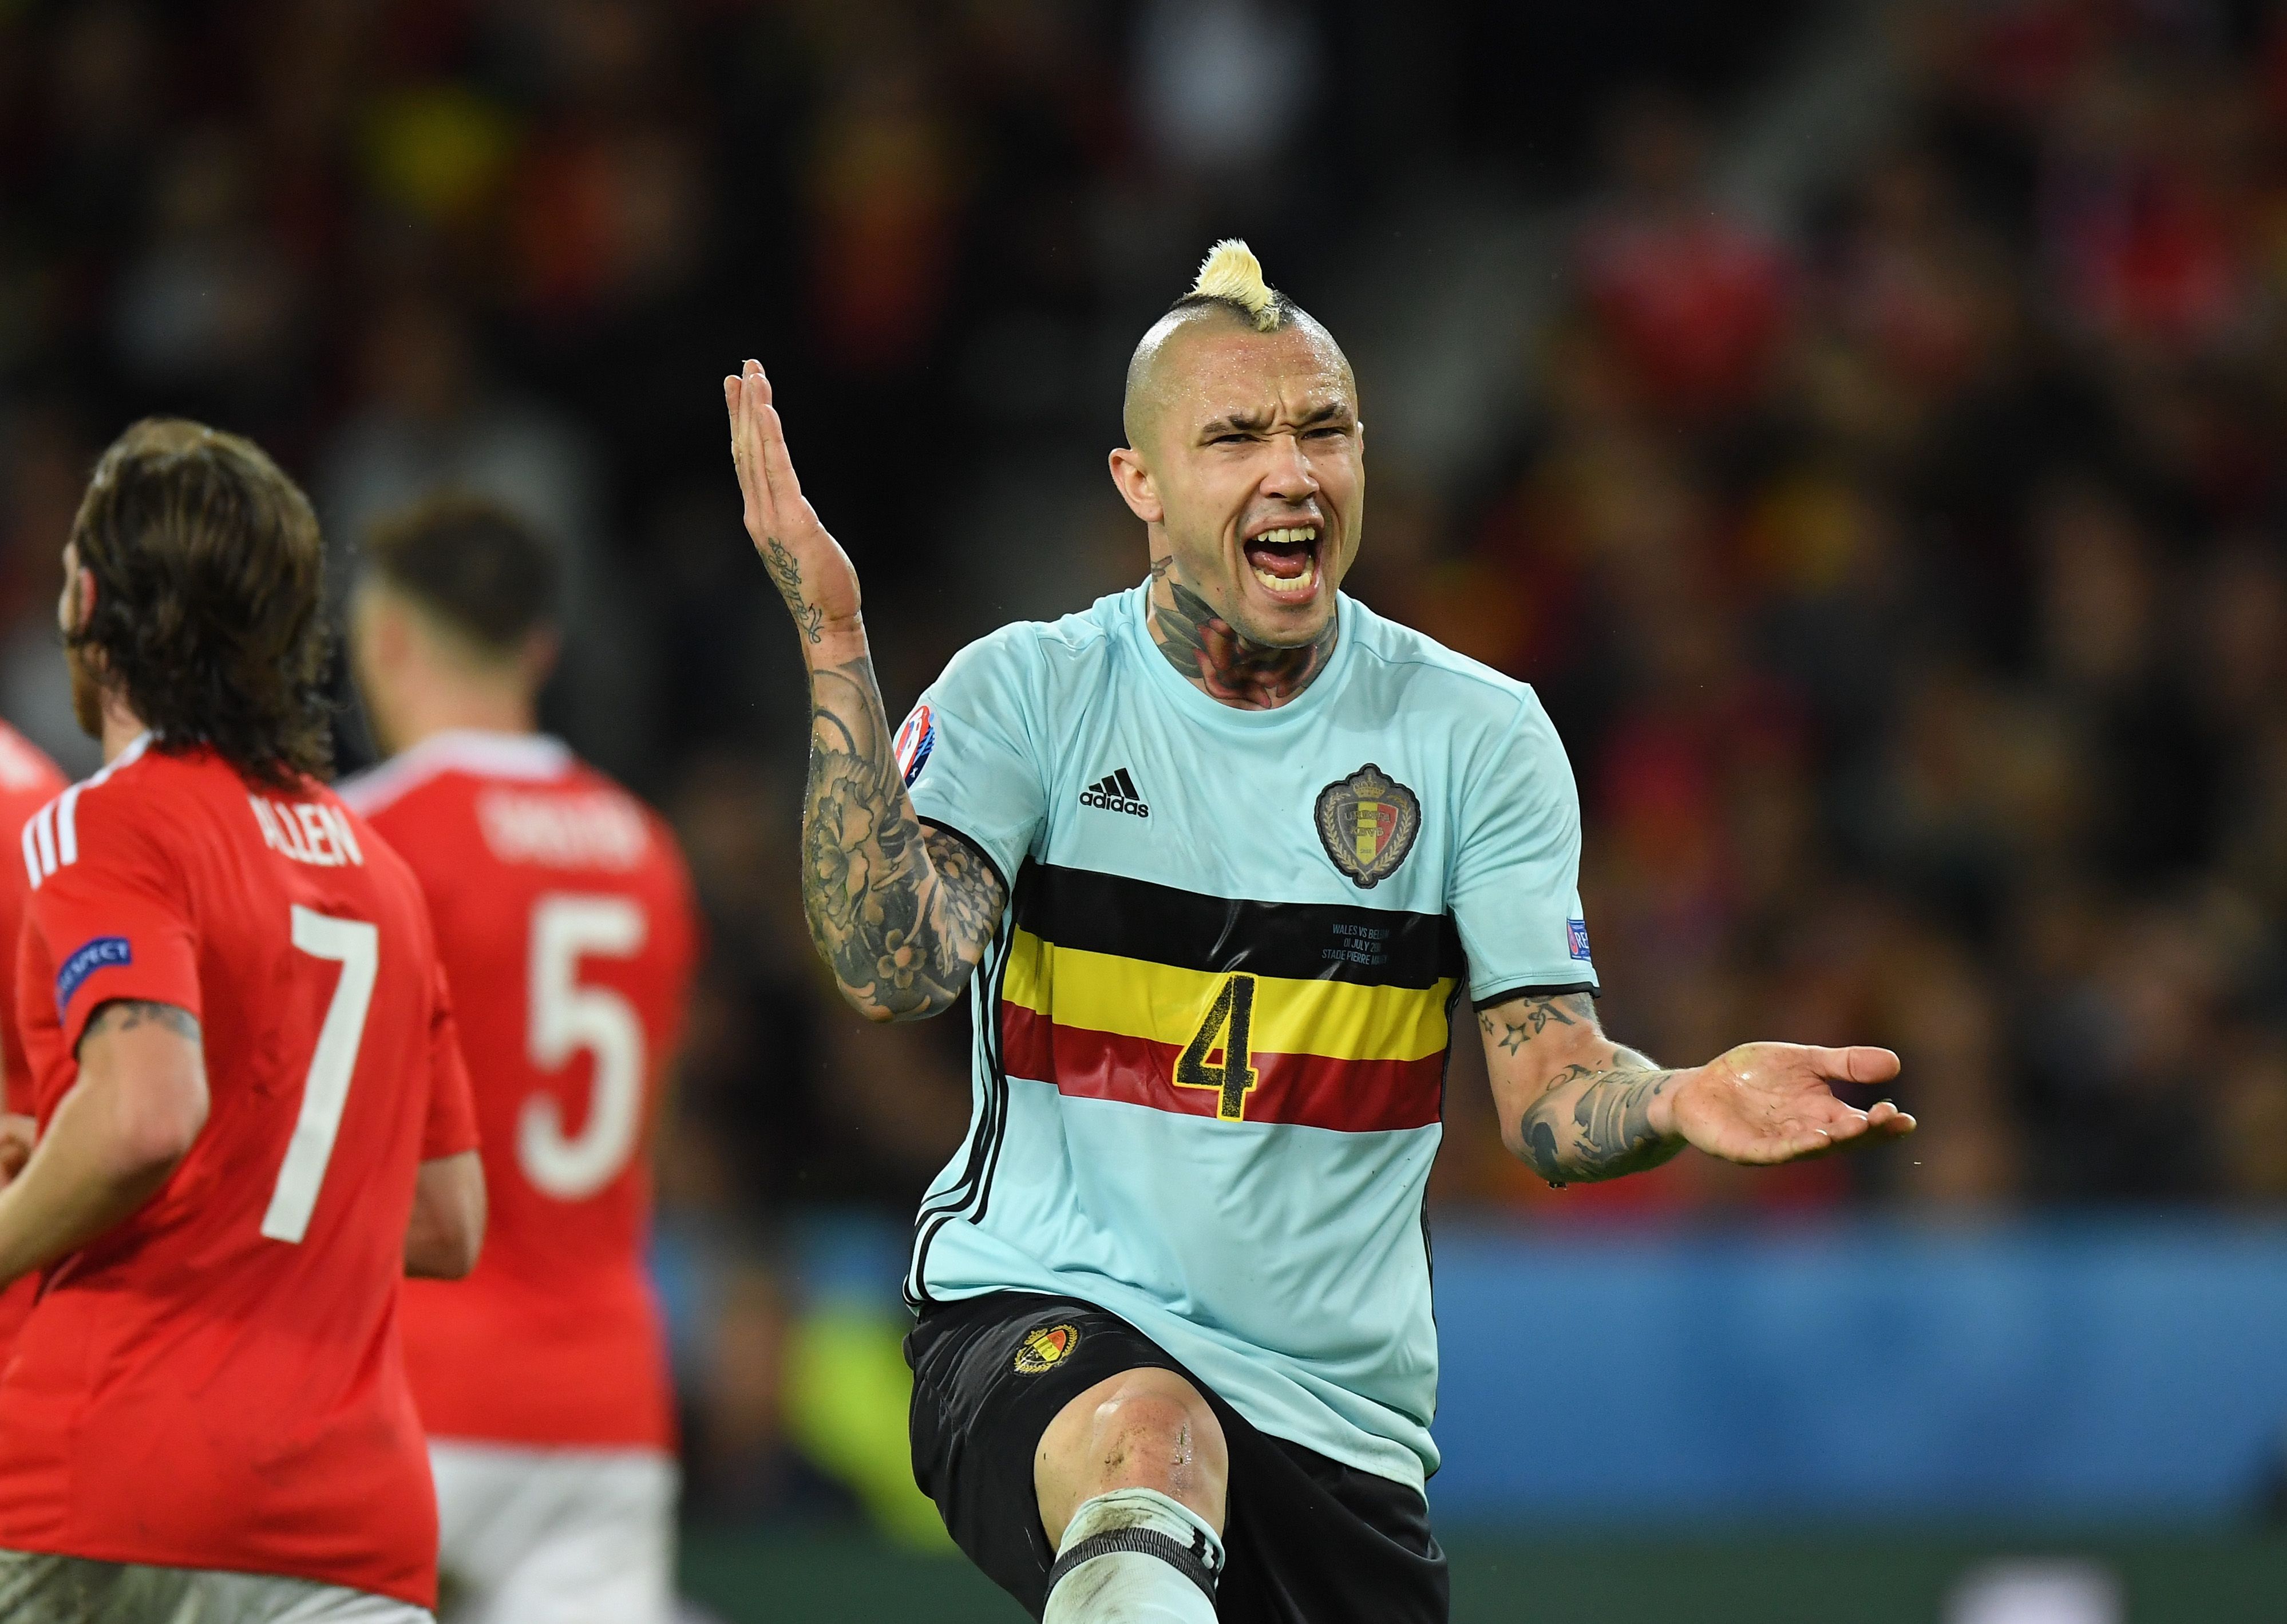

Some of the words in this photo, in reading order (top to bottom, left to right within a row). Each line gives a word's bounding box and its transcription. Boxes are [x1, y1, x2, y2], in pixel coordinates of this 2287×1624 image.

[1079, 791, 1149, 818] adidas
[248, 795, 363, 866] ALLEN
[1332, 924, 1358, 936] WALES
[1359, 926, 1368, 938] VS
[1351, 938, 1370, 951] JULY
[1321, 949, 1346, 960] STADE
[1346, 950, 1371, 965] PIERRE
[515, 890, 647, 1203] 5
[1173, 971, 1259, 1120] 4
[260, 903, 379, 1245] 7
